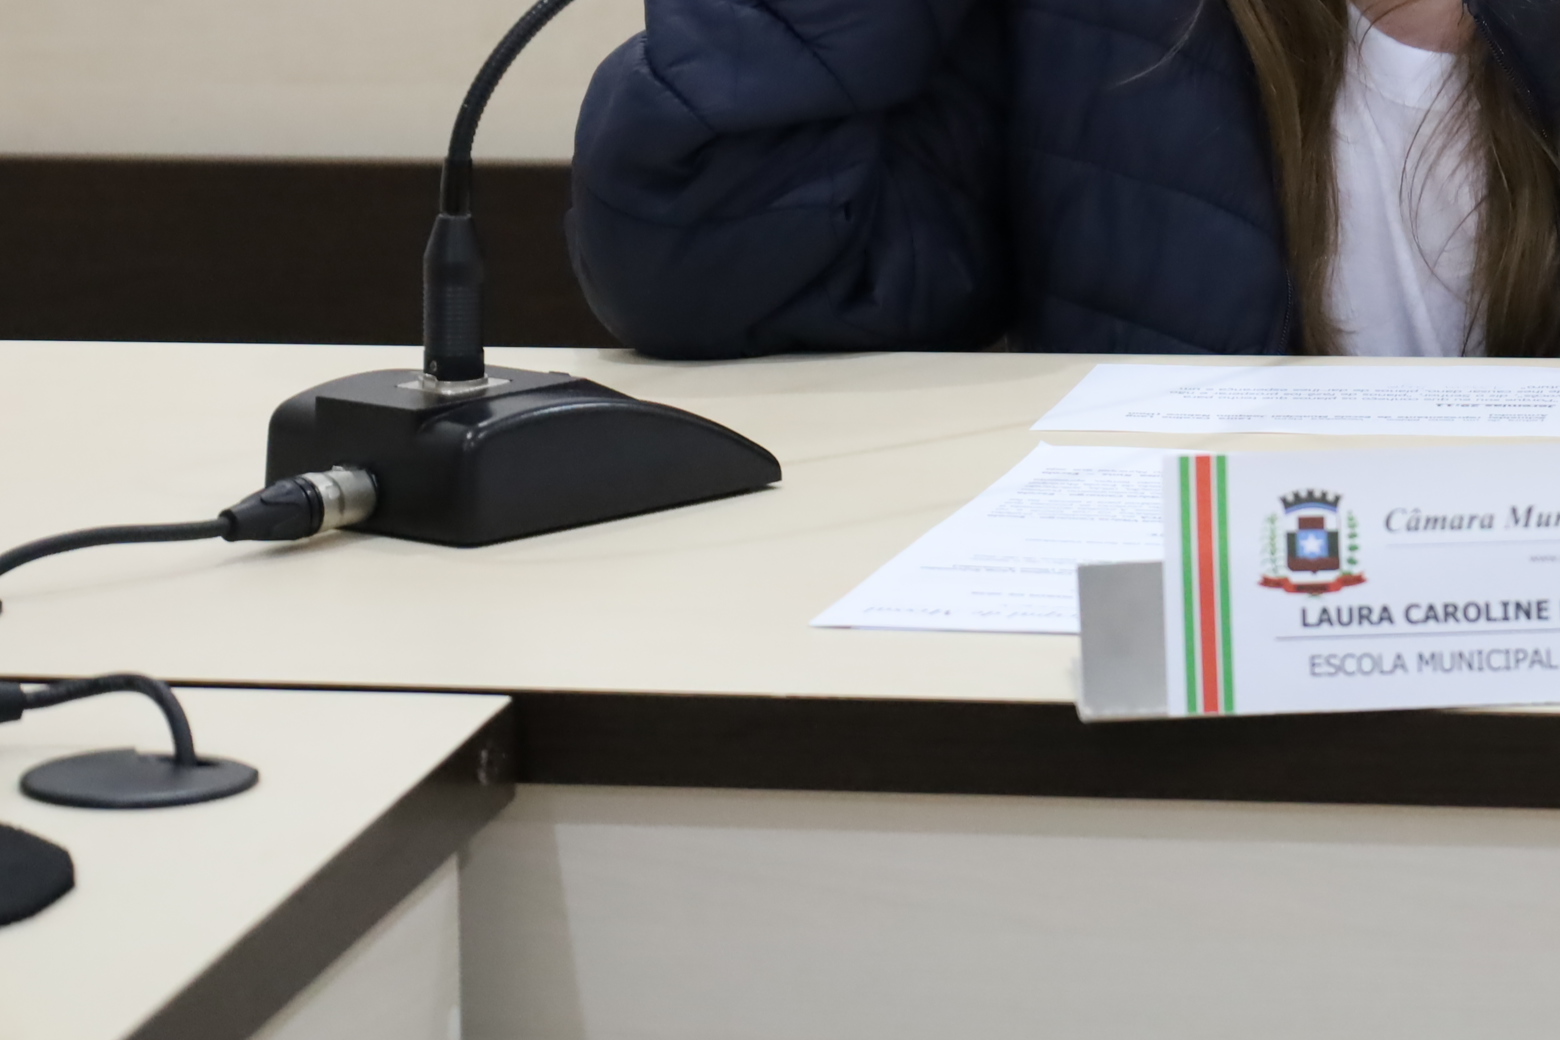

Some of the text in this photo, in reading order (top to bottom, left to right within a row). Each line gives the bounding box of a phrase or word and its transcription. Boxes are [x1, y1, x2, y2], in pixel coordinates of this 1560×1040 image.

[1384, 507, 1495, 534] Câmara
[1300, 604, 1395, 628] LAURA
[1403, 599, 1550, 625] CAROLINE
[1309, 652, 1409, 678] ESCOLA
[1417, 647, 1559, 673] MUNICIPAL
